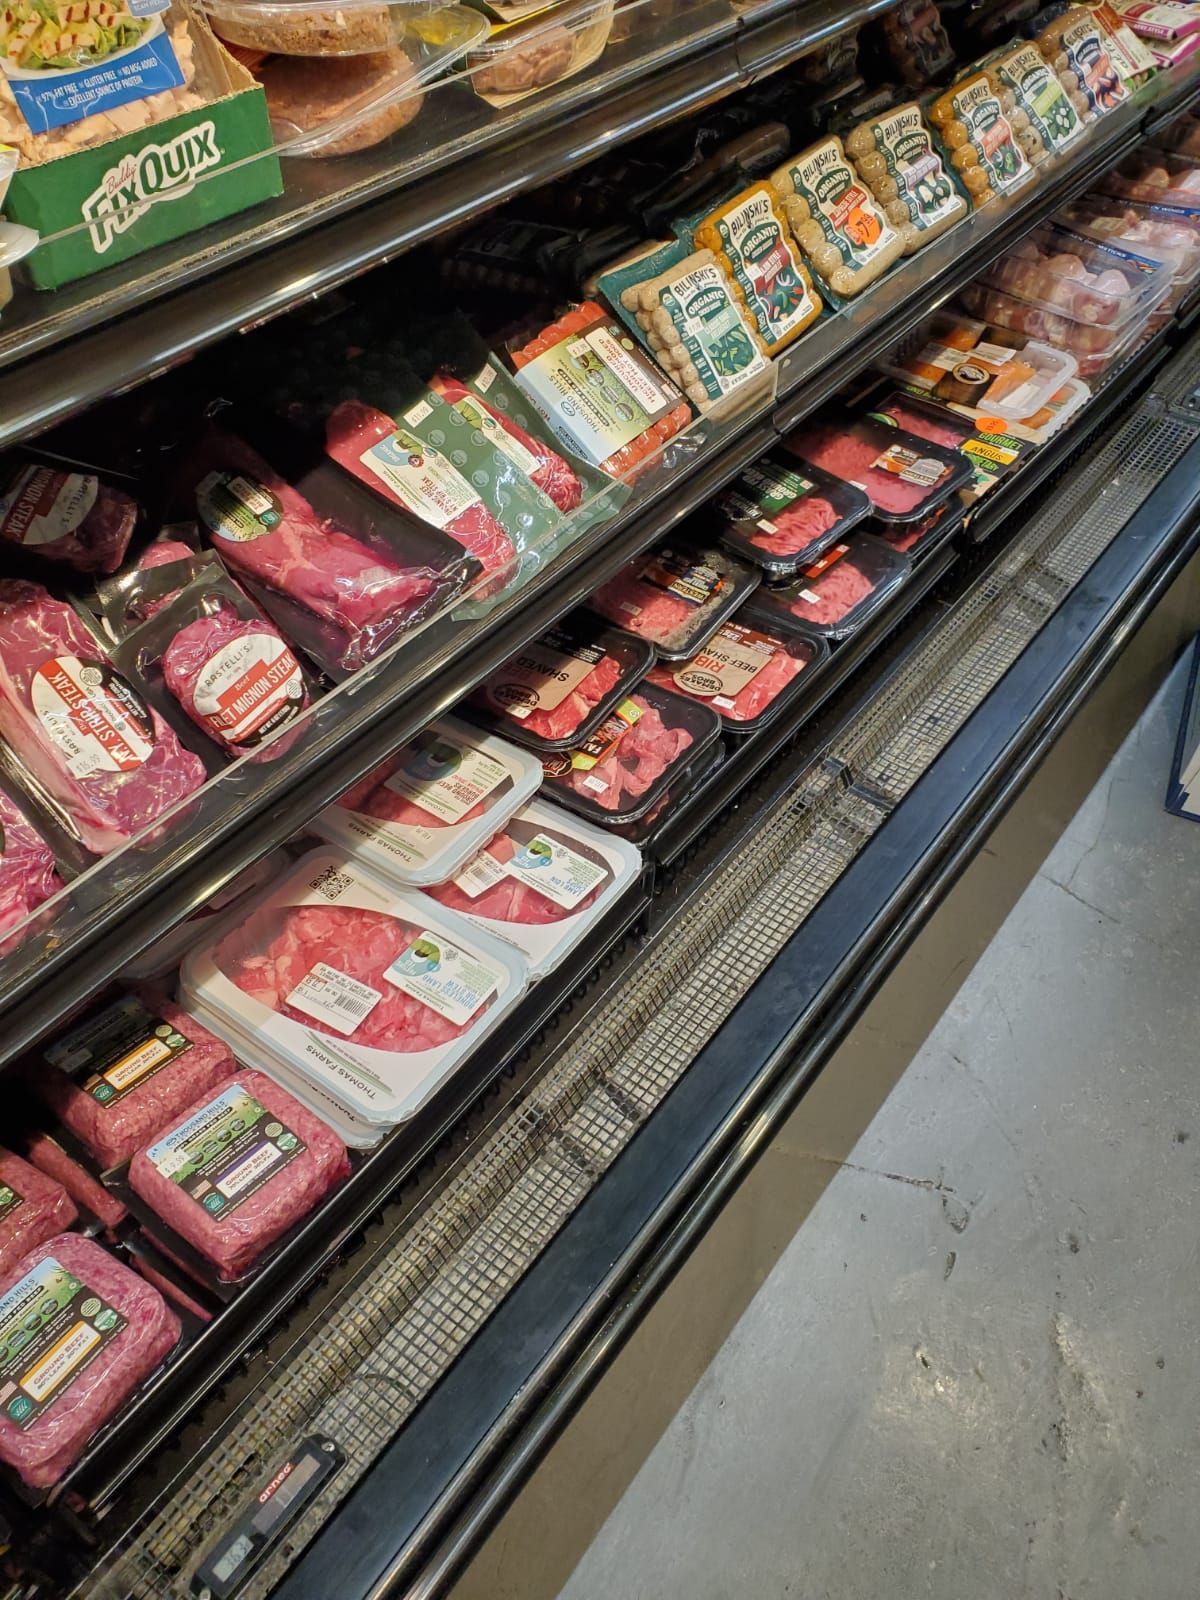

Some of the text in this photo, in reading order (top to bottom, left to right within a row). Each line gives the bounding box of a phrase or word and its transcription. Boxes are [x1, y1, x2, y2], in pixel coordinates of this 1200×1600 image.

[83, 70, 116, 87] GLUTEN FREE
[120, 57, 157, 75] NO MSG ADDED
[40, 82, 78, 101] 97% FAT FREE
[67, 74, 142, 105] EXCELLENT SOURCE OF PROTEIN
[885, 114, 919, 139] BILINSKI'S
[896, 135, 927, 157] ORGANIC
[803, 149, 838, 183] BILINSKI'S
[818, 169, 850, 199] ORGANIC
[731, 199, 769, 236] BILINSKI'S
[743, 224, 779, 257] ORGANIC
[674, 267, 718, 298] BILINSKI'S
[688, 290, 725, 316] ORGANIC
[597, 337, 655, 403] HICKORY SMOKED
[605, 337, 656, 397] BEEF HOT DOGS
[605, 354, 638, 392] UNCURED
[547, 372, 568, 396] HILLS
[565, 393, 600, 433] THOUSAND
[970, 443, 1004, 461] ANGUS
[978, 429, 1024, 452] GOURMET
[419, 483, 434, 498] BEEF
[420, 474, 437, 491] STEAK
[60, 476, 91, 525] RASTELLI'S
[4, 500, 34, 538] STEAK
[203, 644, 252, 687] RASTELLI'S
[516, 653, 569, 684] SHAVED
[691, 671, 714, 685] BROS
[693, 652, 725, 675] RIB
[730, 656, 758, 674] BEEF
[47, 668, 87, 711] STEAK
[230, 676, 273, 715] MIGNON
[264, 652, 297, 684] STEAK
[41, 709, 81, 755] RASTELLI'S
[79, 704, 116, 744] STRIP
[449, 784, 475, 803] GROUND
[453, 780, 479, 799] BURGERS
[347, 820, 412, 863] THOMAS FARMS
[565, 884, 582, 898] LAMB
[421, 973, 441, 989] LAMB
[304, 1044, 338, 1071] FARMS
[336, 1066, 378, 1098] THOMAS
[175, 1100, 226, 1140] THOUSAND HILLS
[223, 1149, 270, 1186] GROUND BEEF
[238, 1168, 254, 1182] LEAN
[14, 1277, 36, 1298] HILLS
[24, 1285, 42, 1302] BEEF
[30, 1351, 67, 1386] GROUND
[63, 1331, 86, 1352] BEEF
[36, 1376, 51, 1390] 80%
[47, 1360, 67, 1378] LEAN
[77, 1334, 91, 1347] FAT
